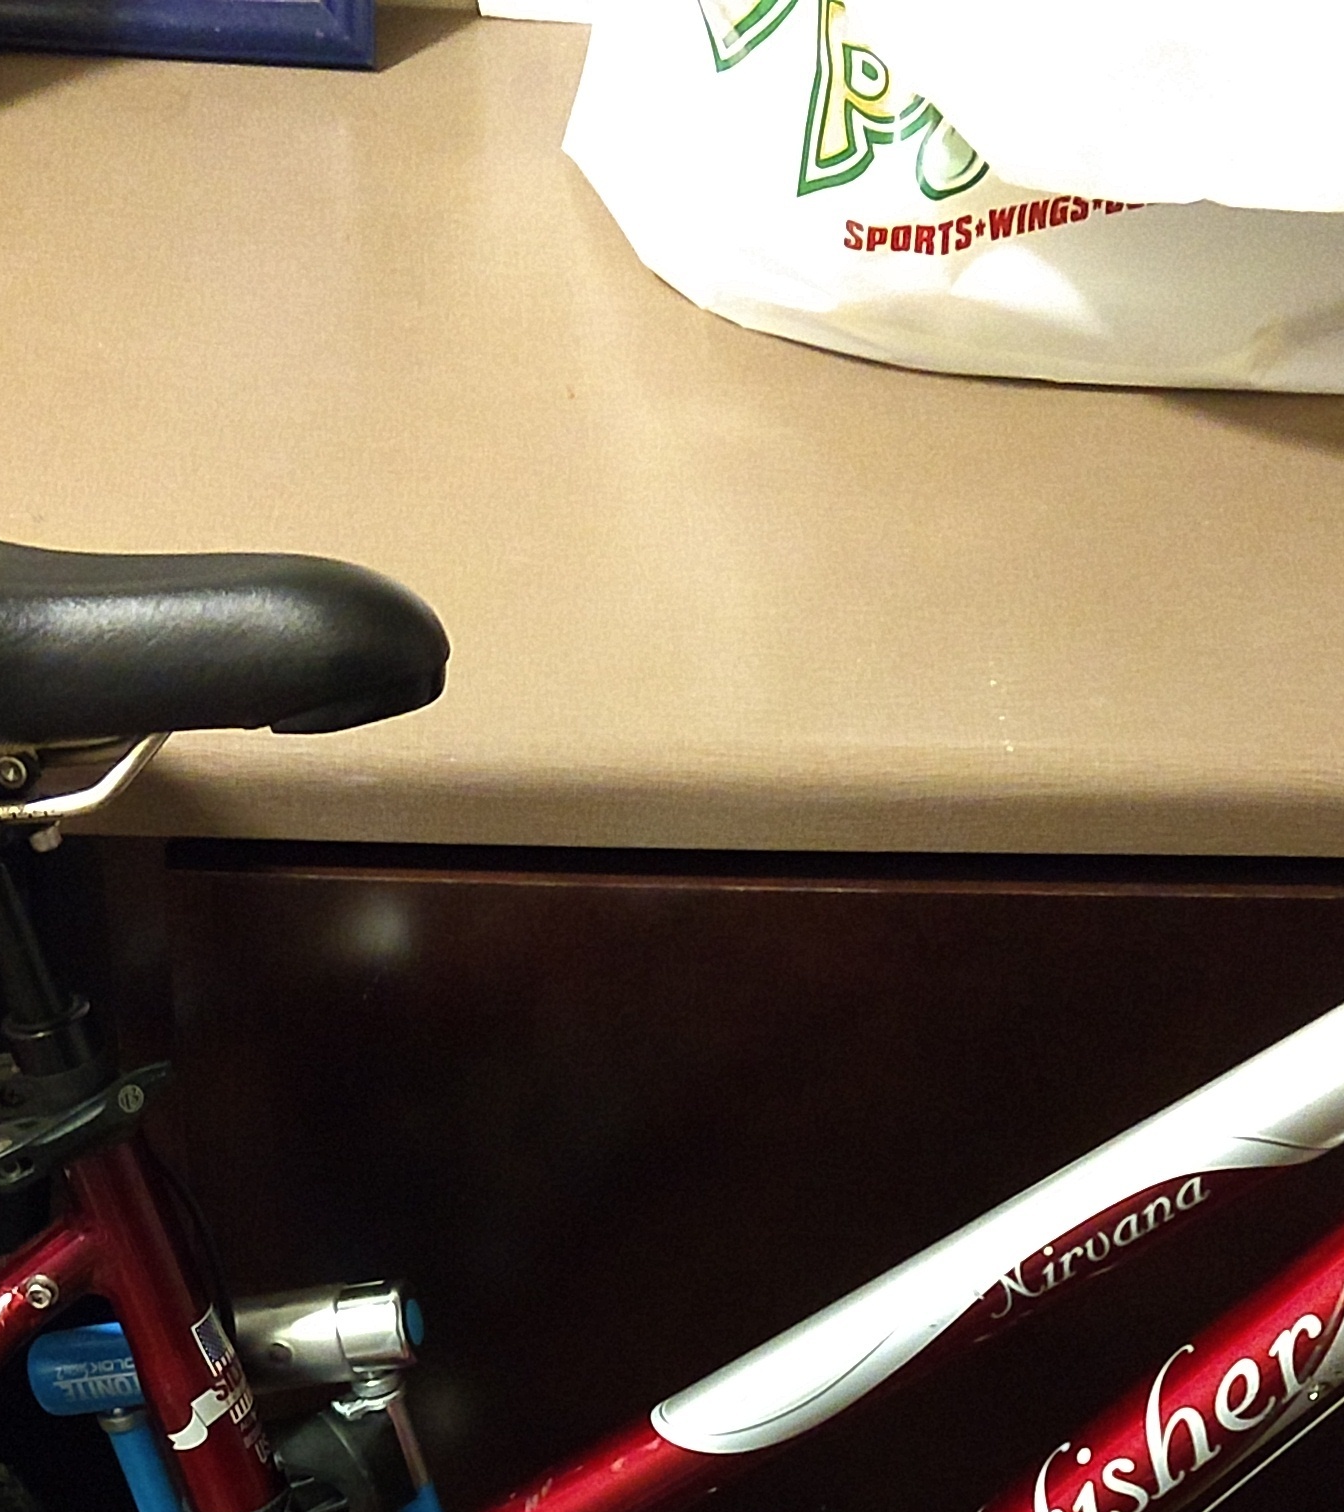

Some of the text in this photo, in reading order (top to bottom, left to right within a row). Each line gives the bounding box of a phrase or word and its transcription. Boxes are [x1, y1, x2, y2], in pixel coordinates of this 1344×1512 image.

[843, 195, 1089, 256] SPORTS WINGS
[974, 1175, 1210, 1319] Nirvana
